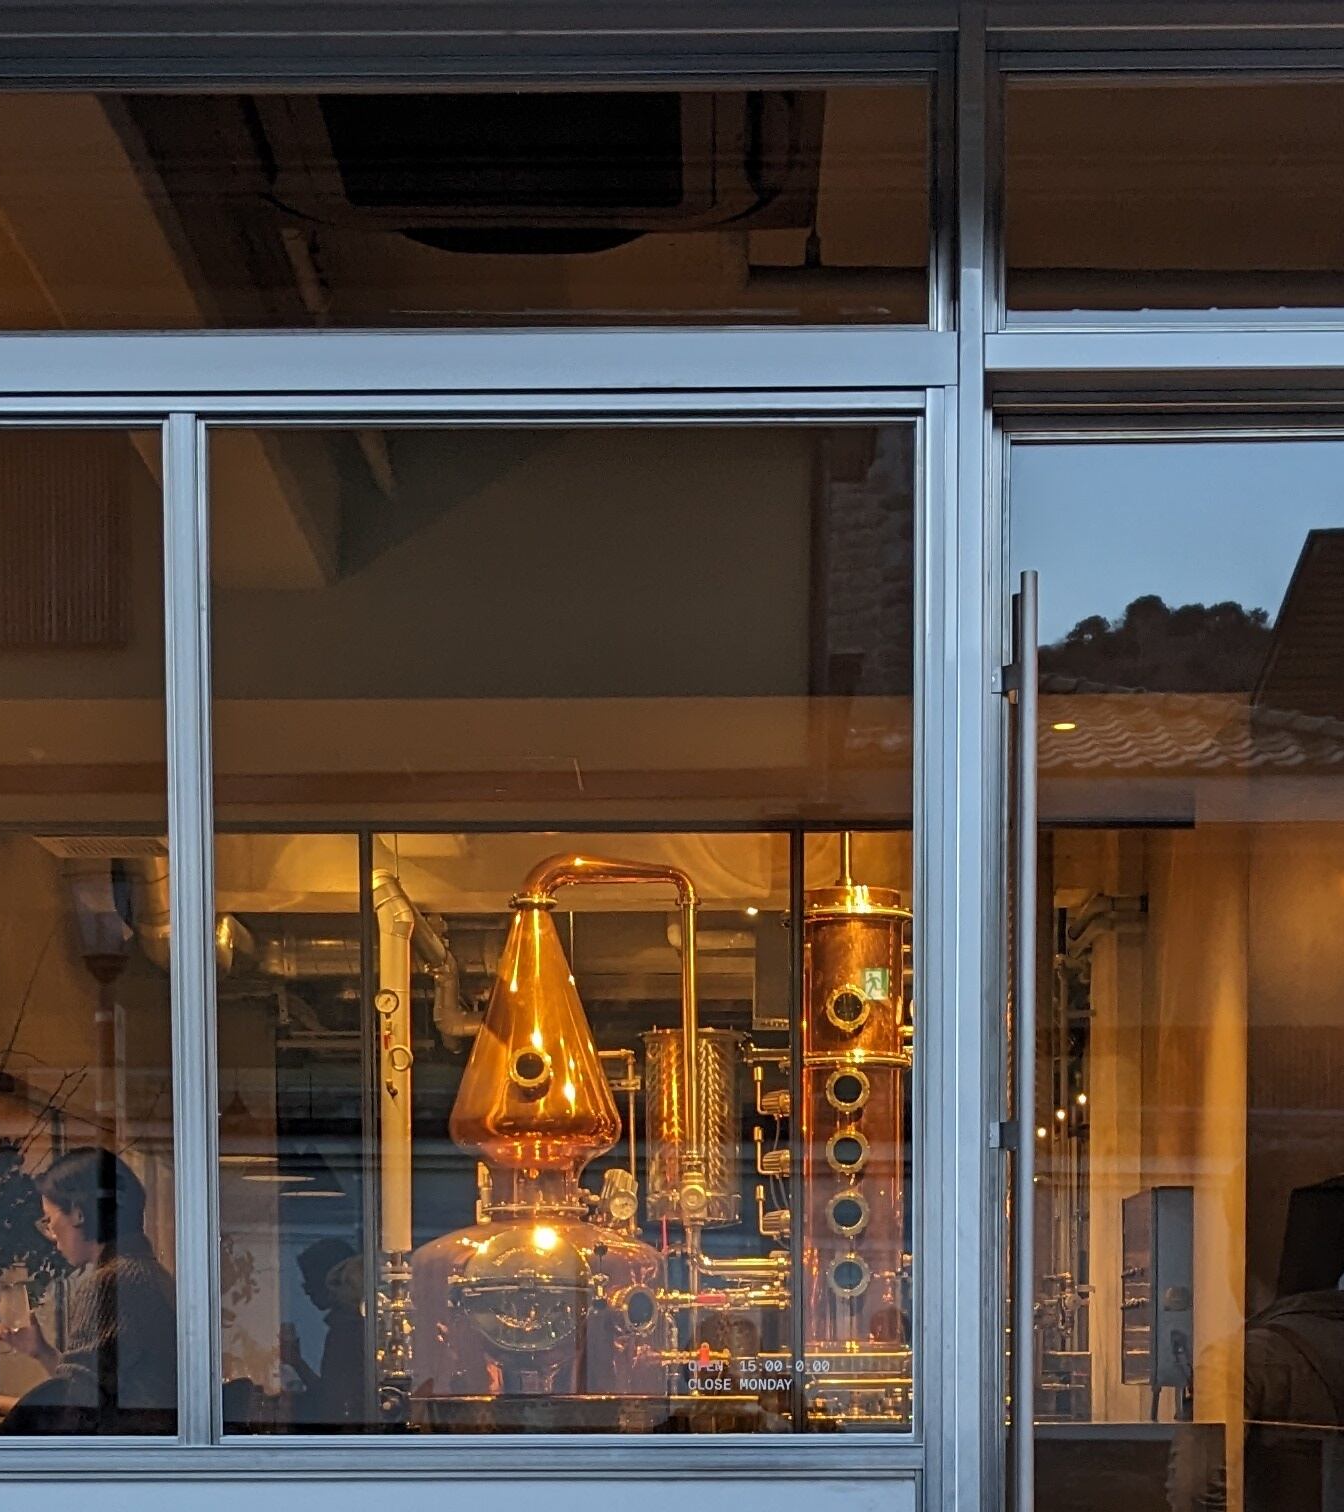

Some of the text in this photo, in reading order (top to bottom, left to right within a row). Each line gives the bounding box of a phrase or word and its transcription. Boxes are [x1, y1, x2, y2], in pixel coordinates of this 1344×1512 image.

[688, 1360, 724, 1372] OPEN
[688, 1378, 793, 1391] CLOSE MONDAY
